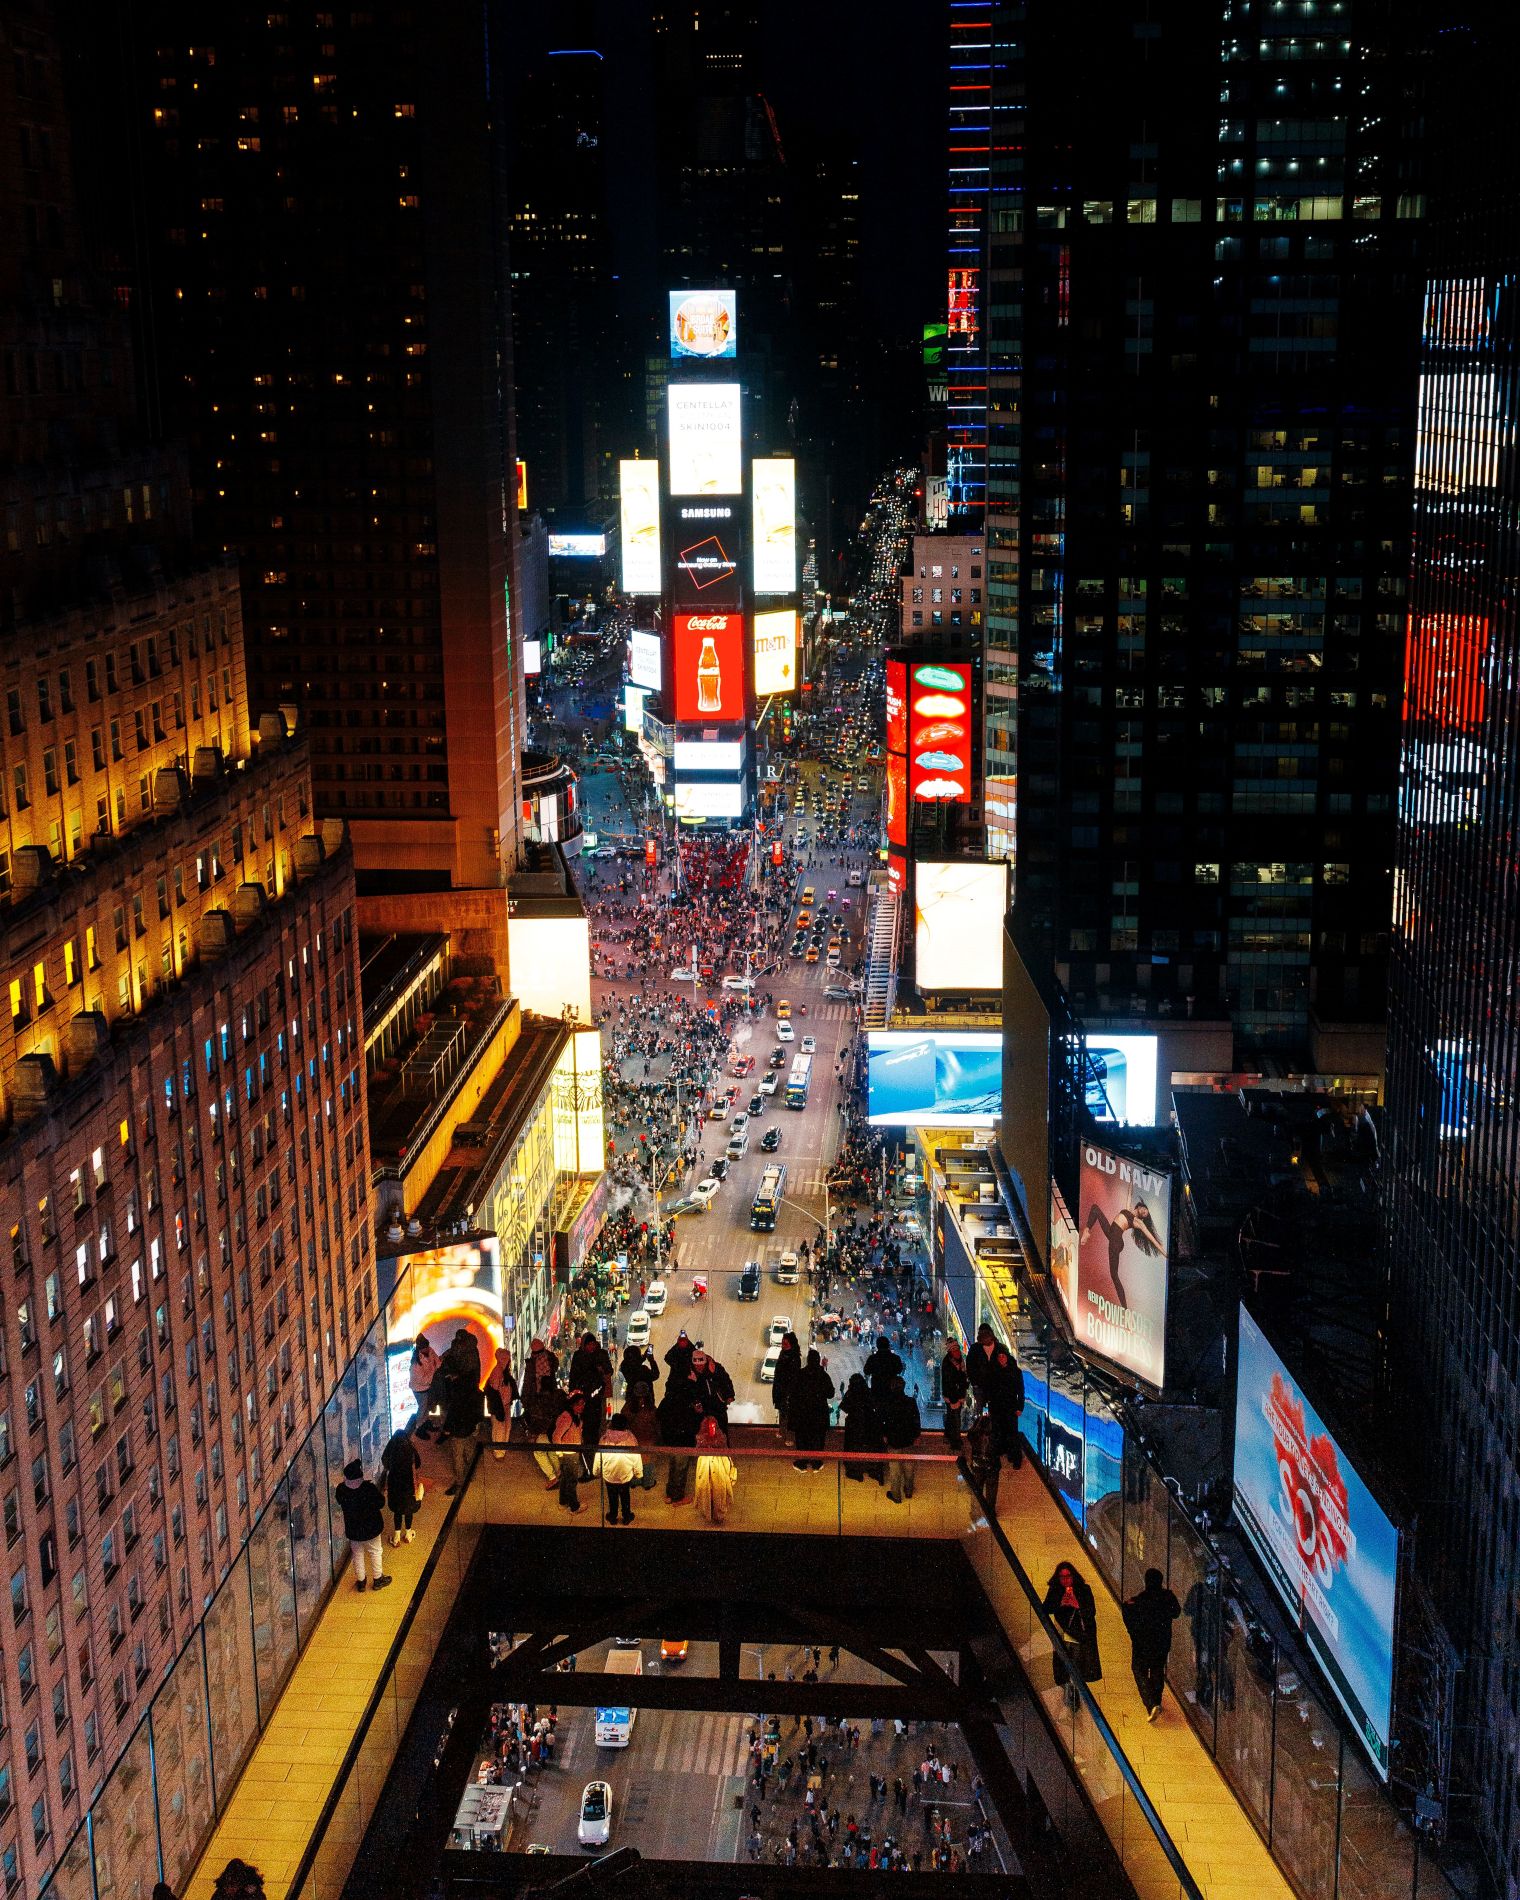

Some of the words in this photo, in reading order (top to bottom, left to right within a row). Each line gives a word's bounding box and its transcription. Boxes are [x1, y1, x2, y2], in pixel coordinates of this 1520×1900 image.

[681, 508, 732, 518] SAMSUNG
[687, 615, 728, 631] Coca-Cola
[1086, 1148, 1117, 1174] OLD
[1120, 1163, 1163, 1196] NAVY
[1088, 1290, 1099, 1305] NEW
[1098, 1295, 1153, 1342] POWERSOFT
[1088, 1312, 1153, 1370] BOUNDLESS
[1278, 1458, 1334, 1591] SOS
